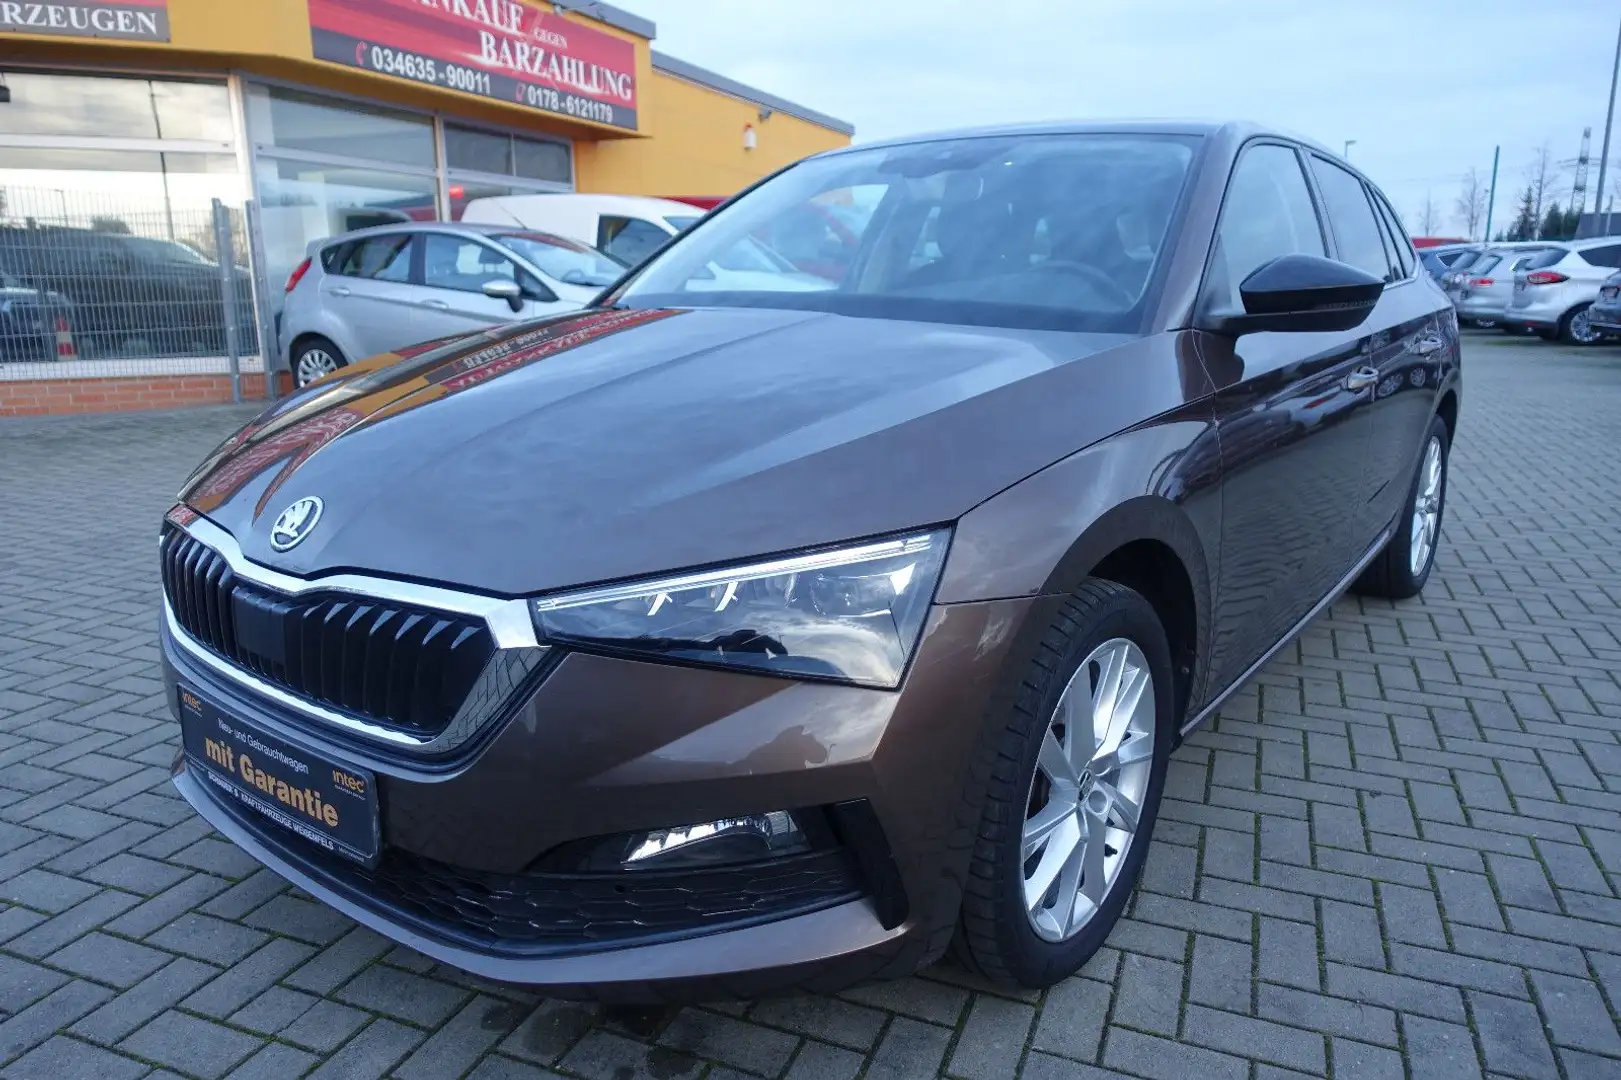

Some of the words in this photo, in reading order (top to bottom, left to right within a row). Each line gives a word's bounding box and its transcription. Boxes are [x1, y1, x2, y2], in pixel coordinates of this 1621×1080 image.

[480, 30, 632, 100] BARZAHLUNG
[233, 729, 247, 743] und
[247, 734, 309, 774] Gebrauchtwagen
[205, 737, 235, 772] mit
[240, 754, 339, 827] Garantie
[333, 769, 365, 794] intec
